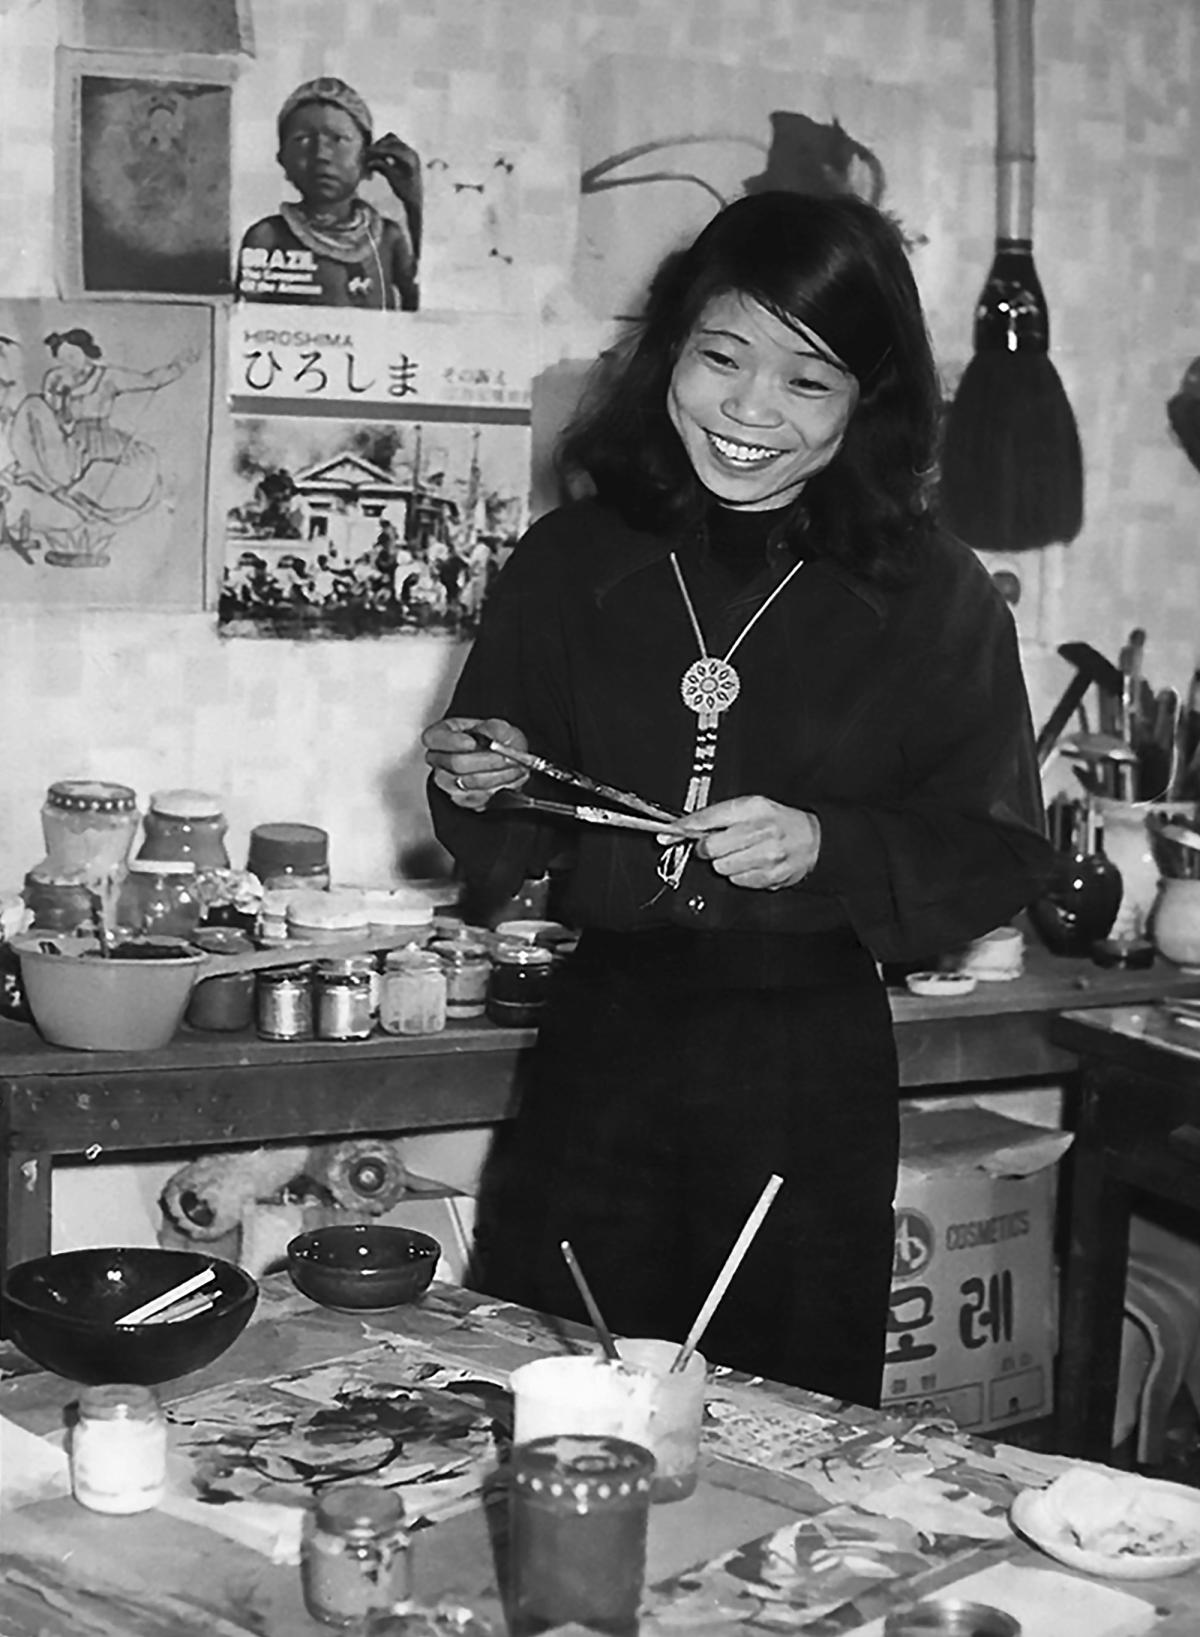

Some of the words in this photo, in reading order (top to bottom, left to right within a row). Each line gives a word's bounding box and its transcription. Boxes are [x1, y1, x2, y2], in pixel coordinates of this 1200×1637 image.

[242, 247, 318, 270] BRAZIL
[244, 329, 353, 346] HIROSHIMA
[243, 350, 418, 397] ひろしま
[946, 1210, 1029, 1250] COSMETICS
